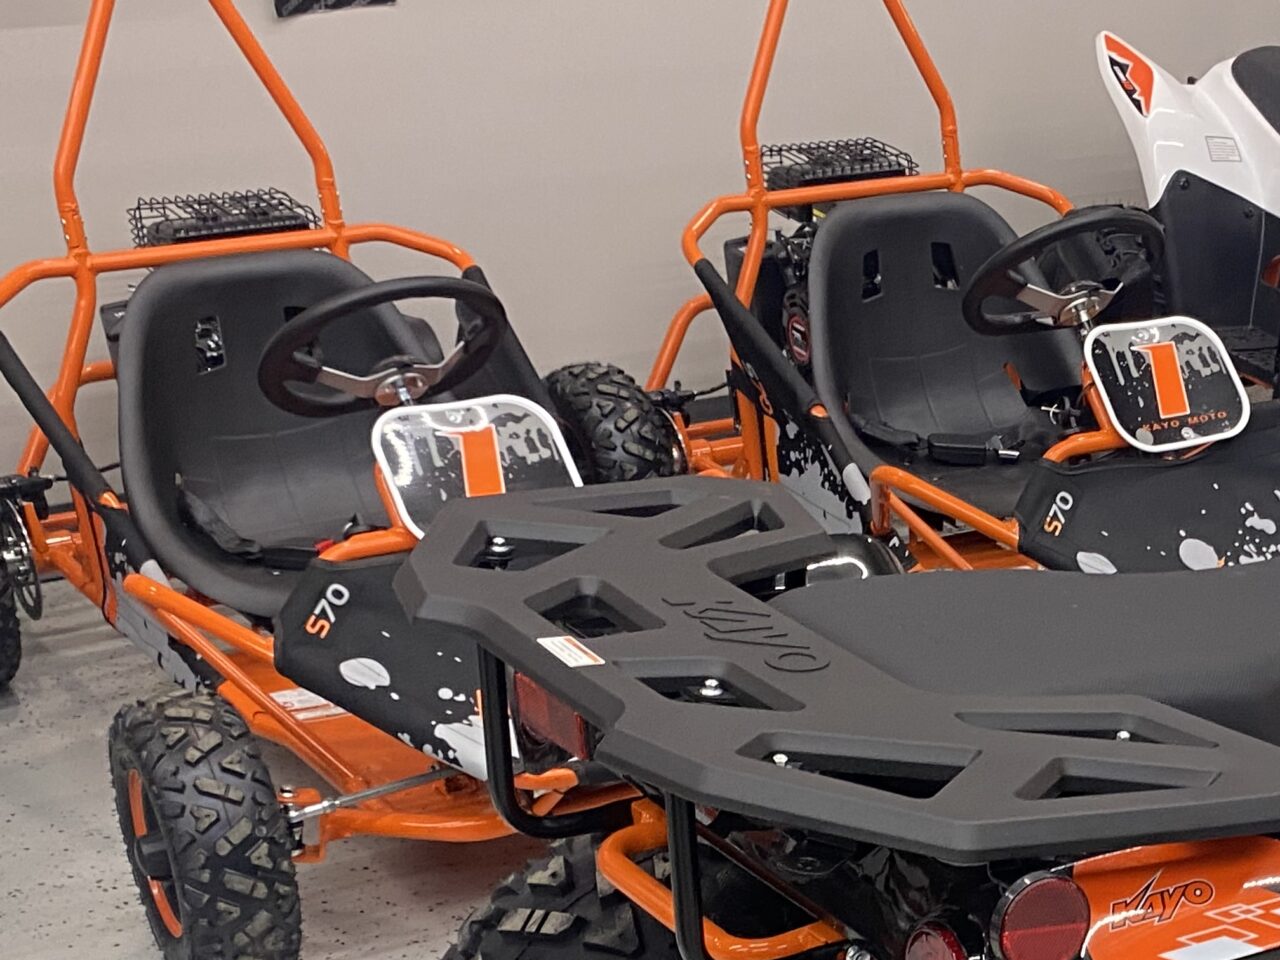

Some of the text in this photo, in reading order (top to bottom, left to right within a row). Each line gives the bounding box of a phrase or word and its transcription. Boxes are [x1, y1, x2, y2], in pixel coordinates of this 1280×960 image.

[1142, 411, 1228, 432] KAYO MOTO
[1043, 490, 1074, 537] S70
[305, 583, 350, 639] S70
[1110, 866, 1216, 932] KAYO
